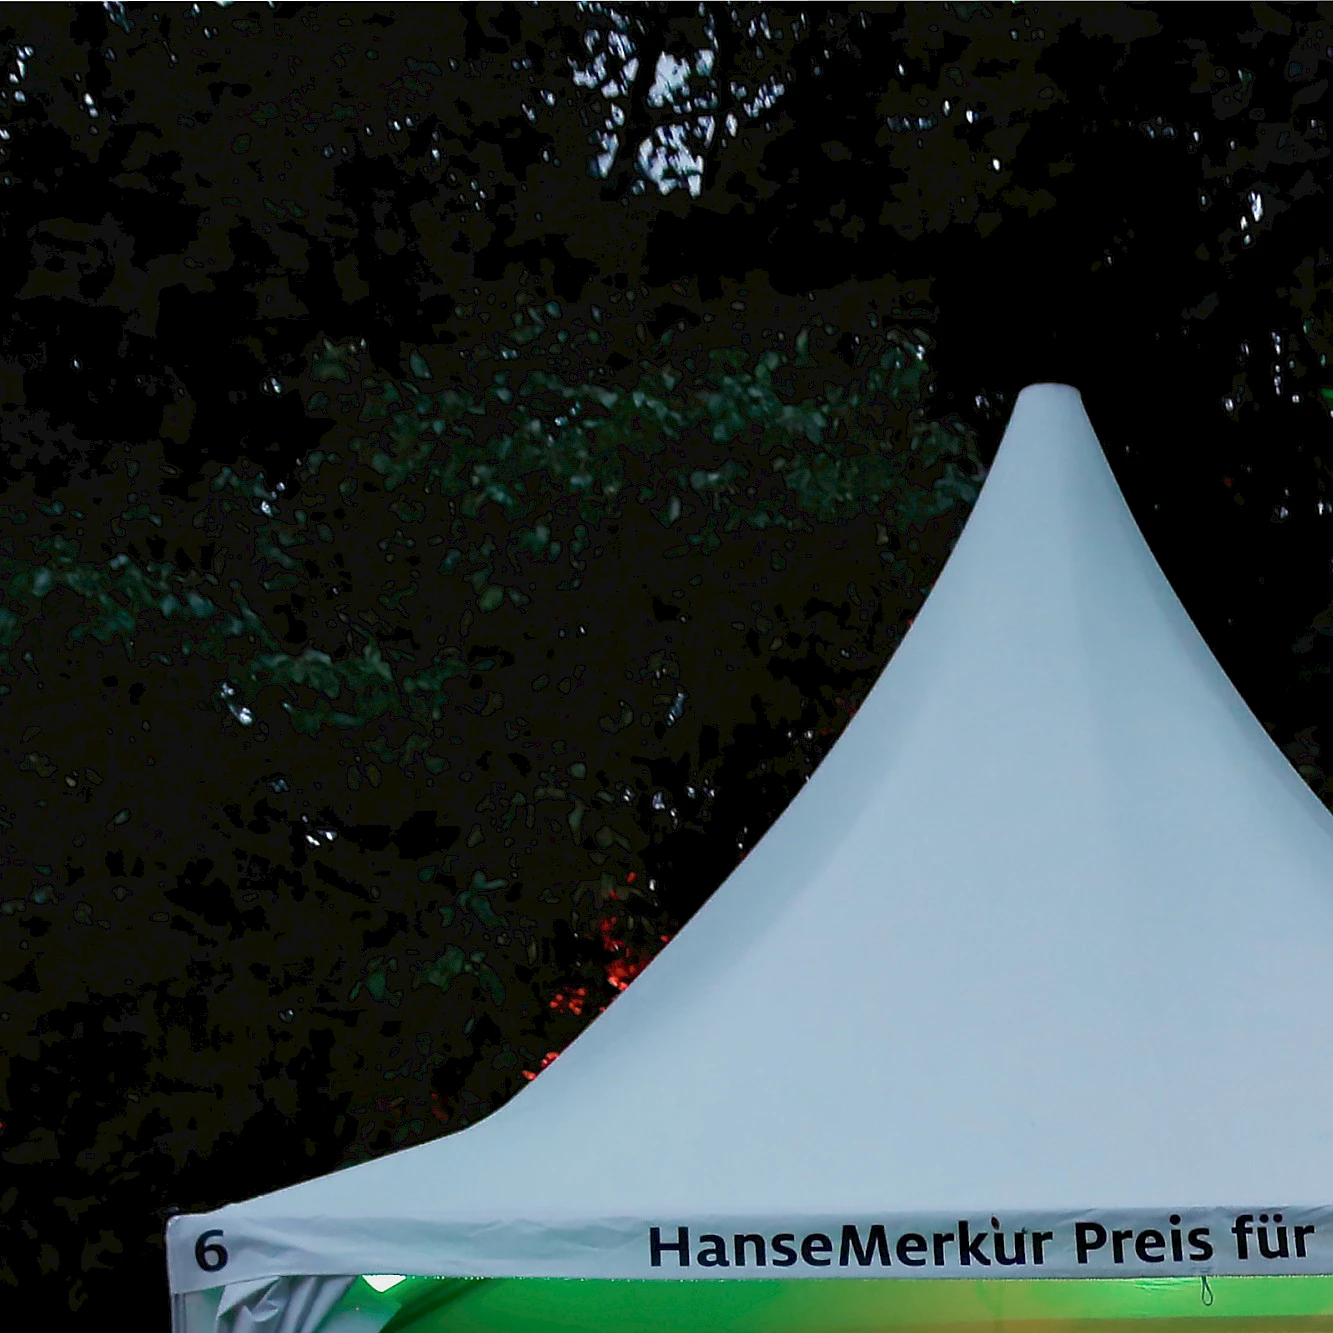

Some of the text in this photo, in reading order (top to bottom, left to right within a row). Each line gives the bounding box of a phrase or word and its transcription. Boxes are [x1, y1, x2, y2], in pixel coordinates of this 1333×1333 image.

[194, 1229, 228, 1272] 6
[649, 1220, 1052, 1267] HanseMerkur
[1074, 1214, 1213, 1265] Preis
[1232, 1213, 1315, 1260] für
